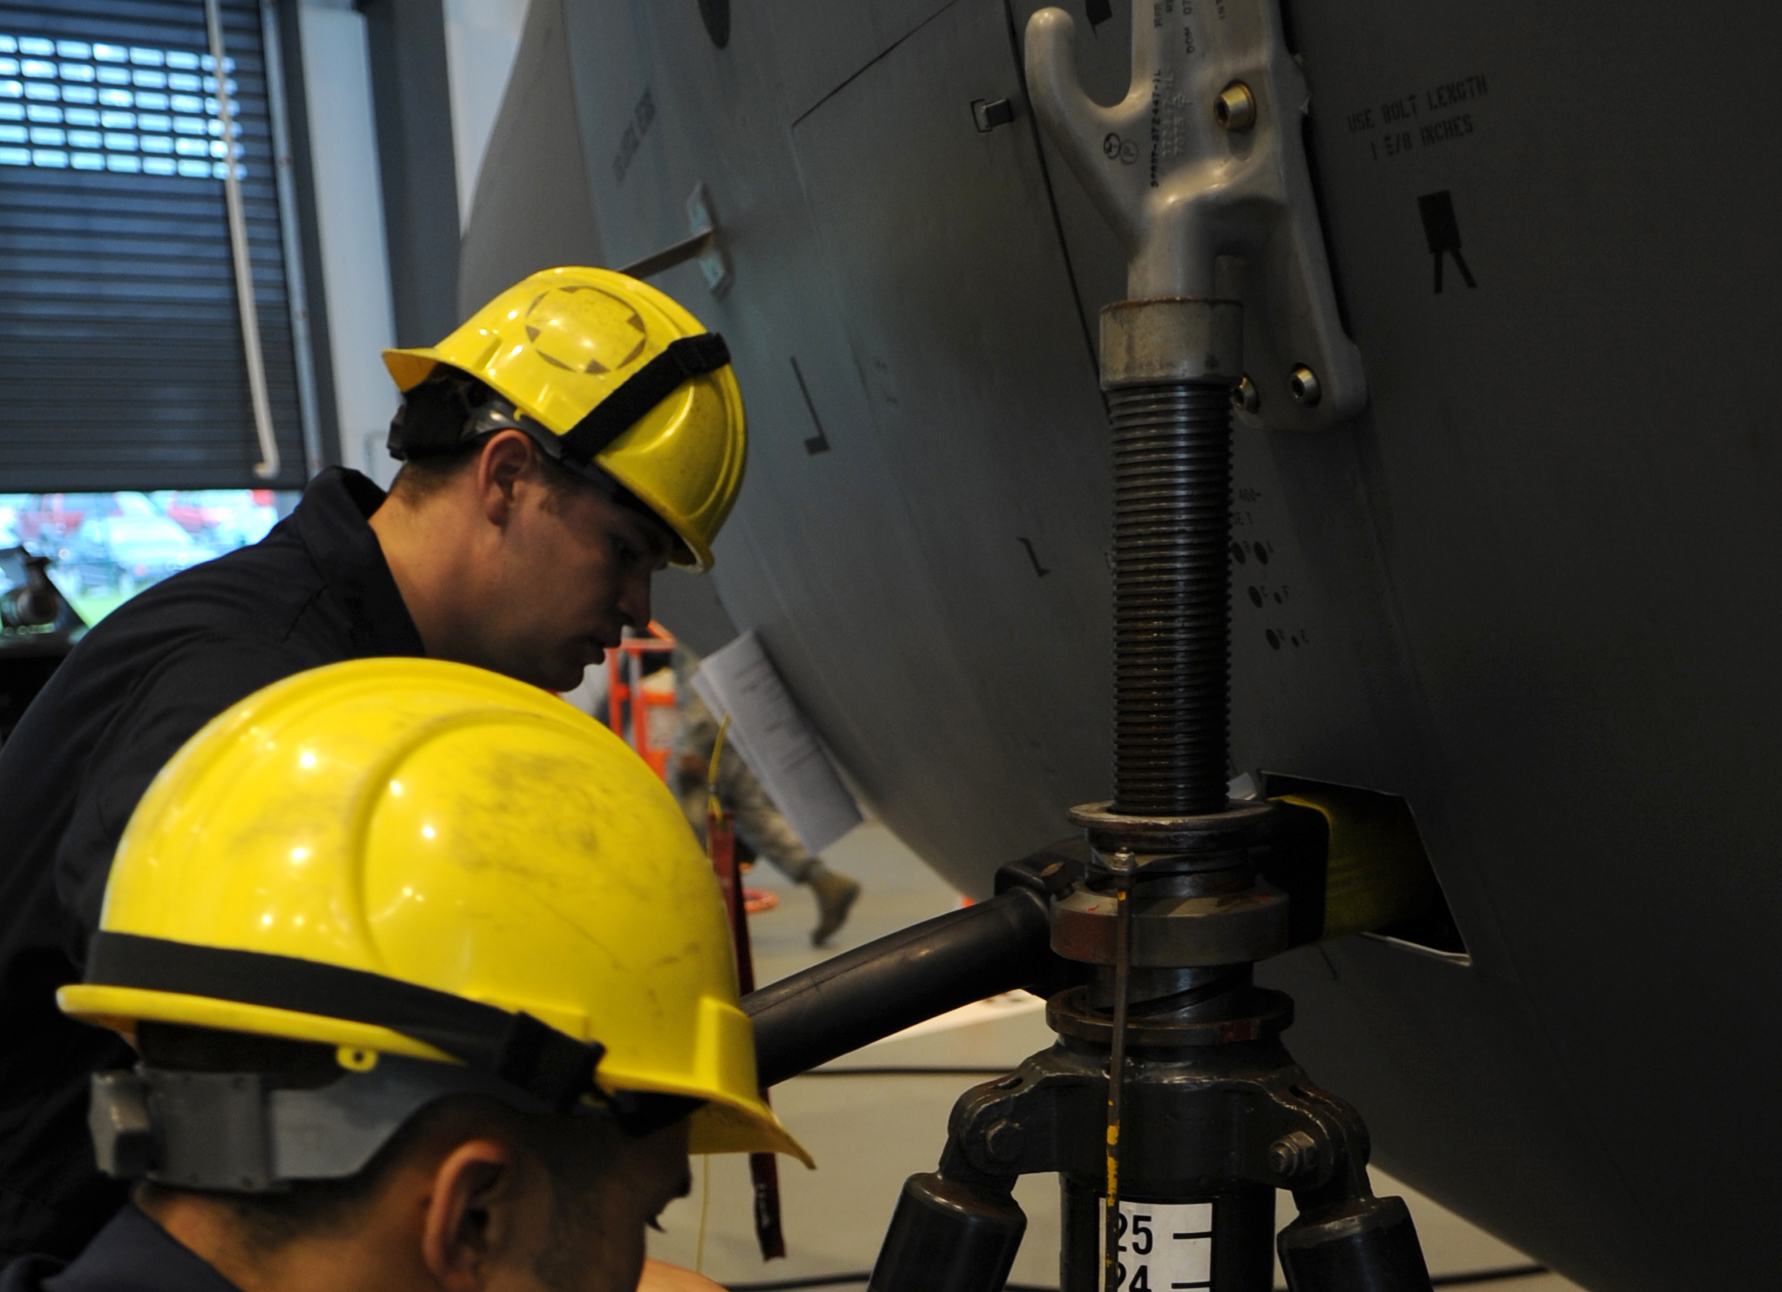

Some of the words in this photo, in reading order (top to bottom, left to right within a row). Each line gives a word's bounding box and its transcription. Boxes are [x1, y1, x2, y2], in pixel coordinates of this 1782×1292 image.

[1347, 108, 1375, 133] USE
[1381, 94, 1417, 124] BOLT
[1426, 74, 1488, 111] LENGTH
[1420, 113, 1473, 147] INCHES
[1118, 1213, 1152, 1255] 25
